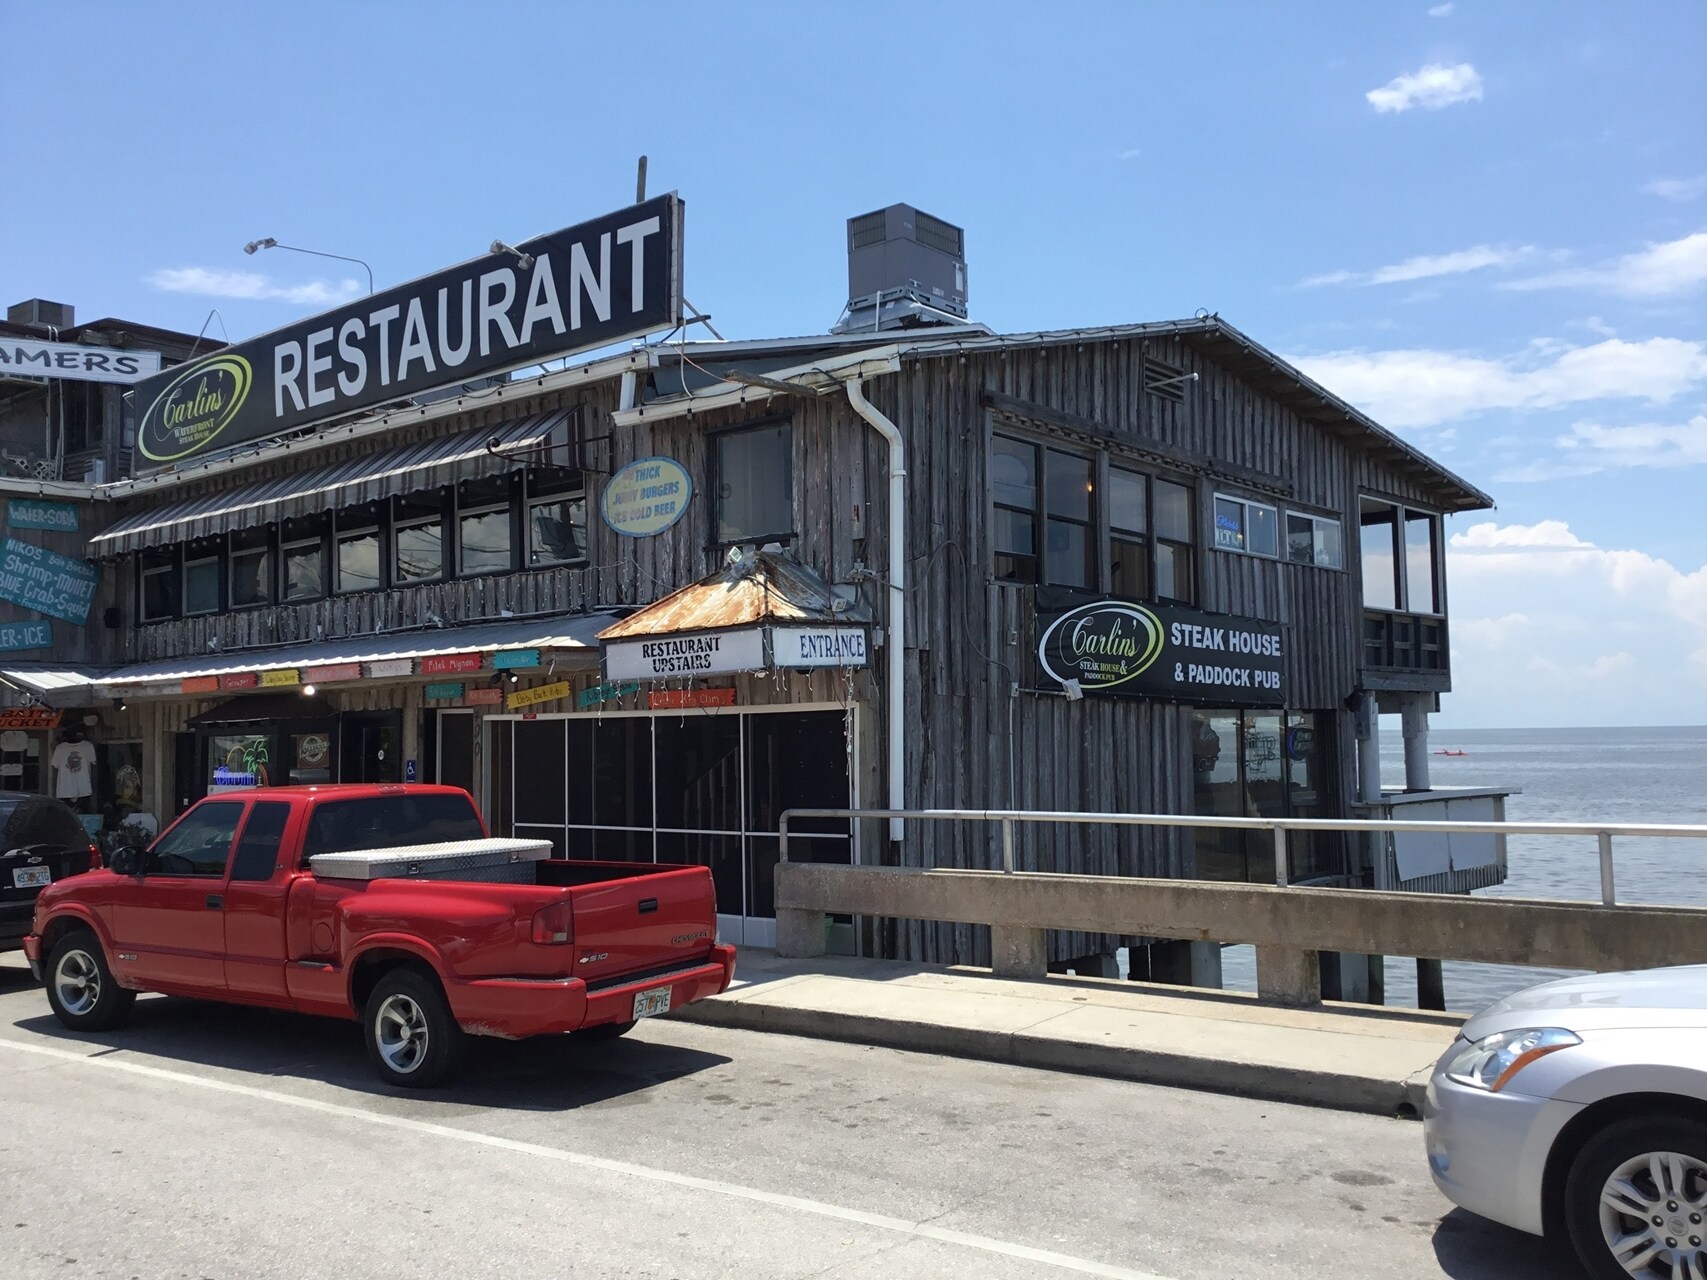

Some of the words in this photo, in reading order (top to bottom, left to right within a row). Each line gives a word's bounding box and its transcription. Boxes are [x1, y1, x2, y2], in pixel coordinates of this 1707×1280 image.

[274, 215, 660, 417] RESTAURANT
[158, 370, 227, 431] Carlin's
[174, 417, 215, 439] WATERFRONT
[178, 435, 194, 445] STEAK
[194, 431, 211, 443] HOUSE
[635, 465, 661, 482] THICK
[640, 480, 680, 501] BURGERS
[654, 501, 676, 518] BEER
[642, 636, 722, 659] RESTAURANT
[799, 634, 865, 660] ENTRANCE
[1067, 617, 1141, 660] Carlin's
[1171, 622, 1226, 651] STEAK
[1228, 630, 1281, 657] HOUSE
[652, 653, 712, 673] UPSTAIRS
[1079, 660, 1100, 672] STEAK
[1100, 662, 1120, 674] HOUSE
[1119, 659, 1128, 675] &
[1084, 672, 1106, 681] PADDOCK
[1105, 674, 1116, 682] PUB
[1174, 662, 1185, 682] &
[1188, 663, 1251, 687] PADDOCK
[1254, 670, 1281, 690] PUB
